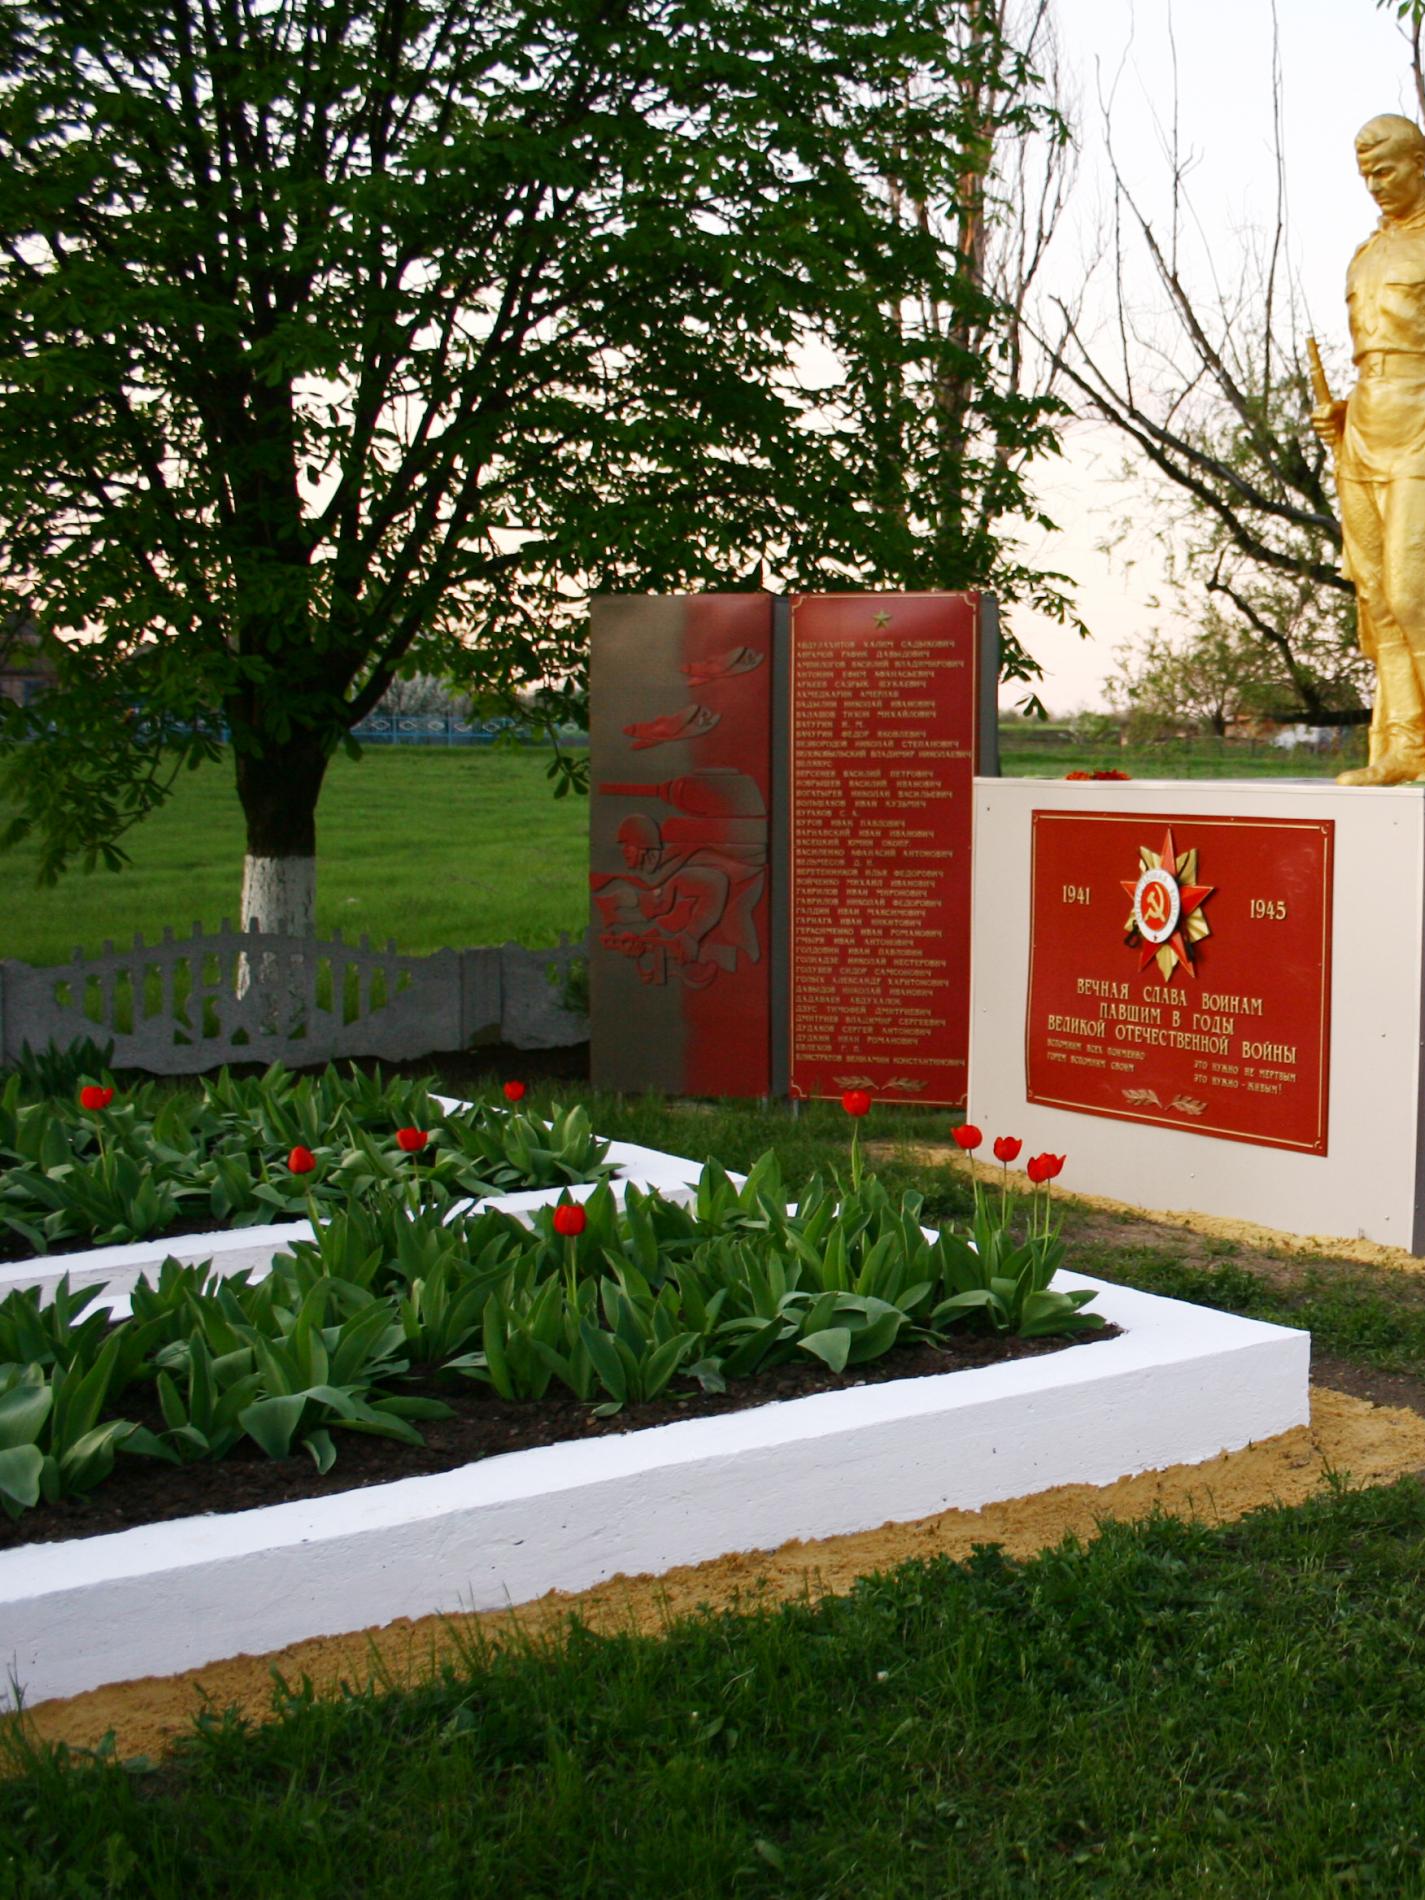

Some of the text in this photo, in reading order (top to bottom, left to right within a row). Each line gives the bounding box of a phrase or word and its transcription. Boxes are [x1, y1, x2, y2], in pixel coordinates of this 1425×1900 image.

[845, 888, 868, 896] ИВАН
[1062, 885, 1090, 905] 1941
[1250, 899, 1286, 920] 1945
[859, 927, 883, 936] ИВАН
[889, 928, 942, 937] РОМАНОВИЧ
[1077, 978, 1264, 1016] ВЕЧНАЯ СЛАВА ВОИНАМ
[1100, 1002, 1235, 1035] ПАВШИМ В ГОДЫ
[841, 1023, 873, 1034] СЕРГЕЙ
[1048, 1014, 1297, 1064] ВЕЛИКОЙ ОТЕЧЕСТВЕННОЙ ВОЙНЫ
[1194, 1060, 1208, 1070] ЭТО
[1212, 1062, 1239, 1074] НУЖНО
[1244, 1067, 1255, 1077] НЕ
[1194, 1073, 1208, 1083] ЭТО
[1212, 1076, 1239, 1089] НУЖНО
